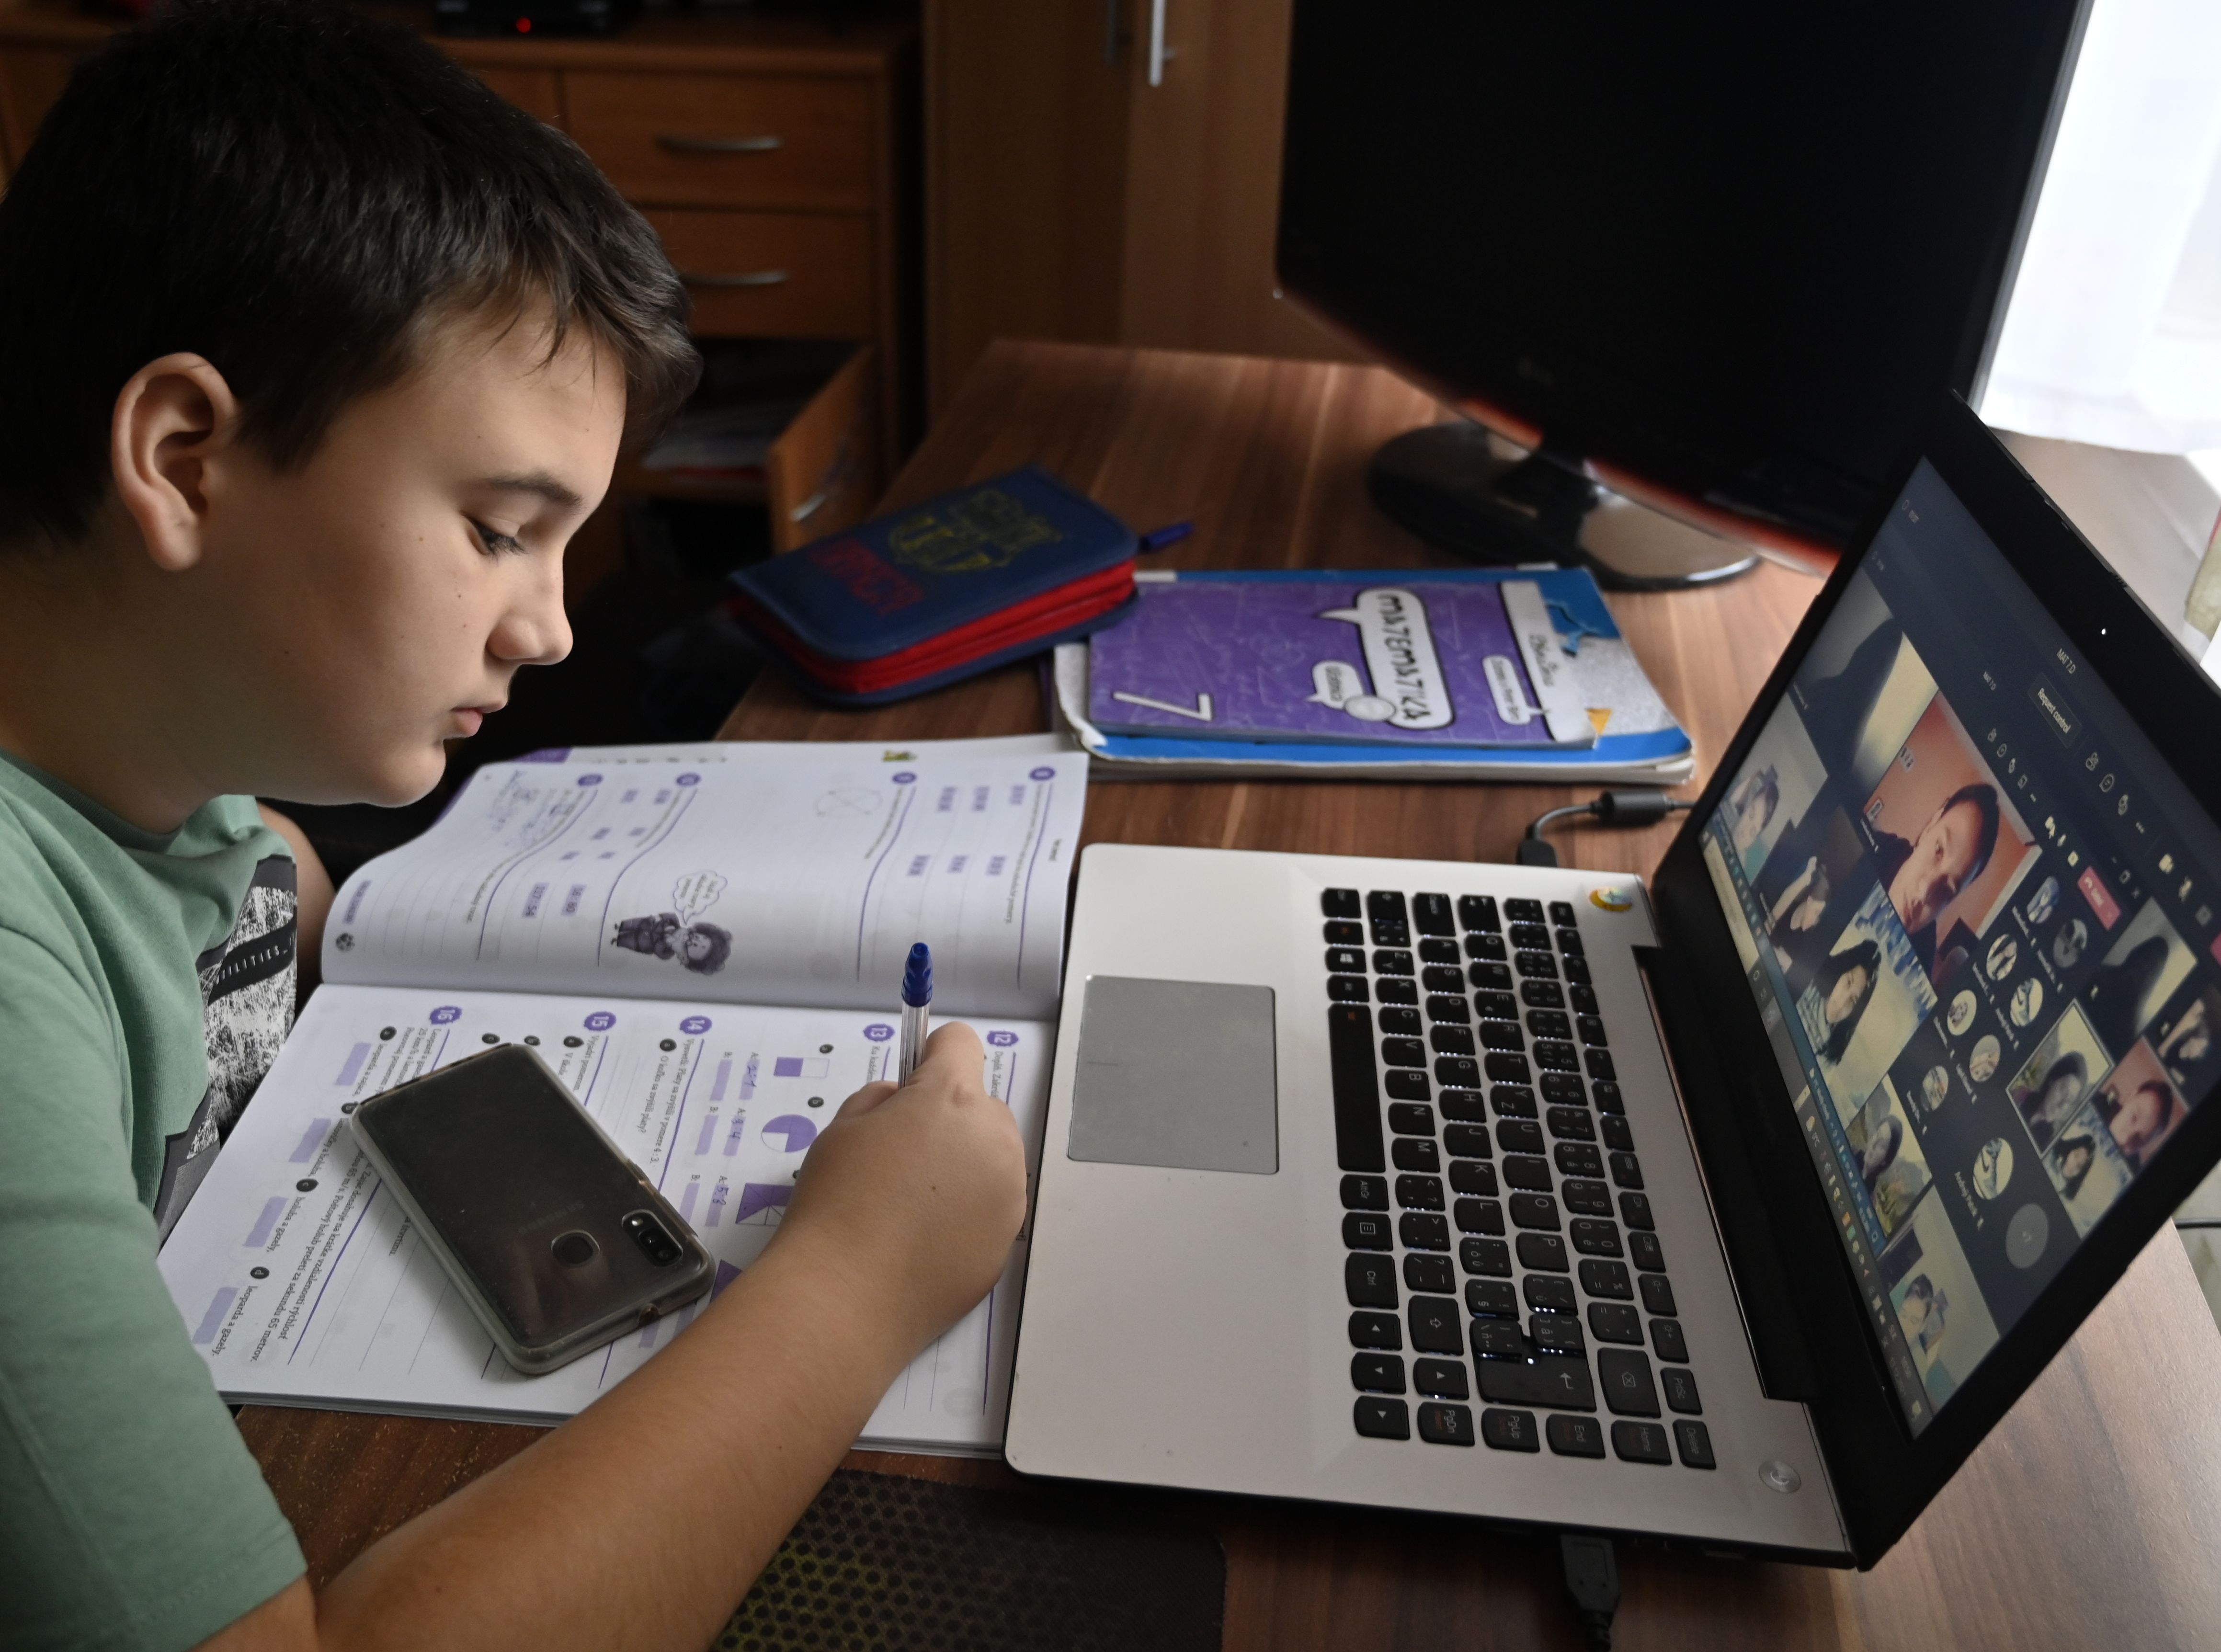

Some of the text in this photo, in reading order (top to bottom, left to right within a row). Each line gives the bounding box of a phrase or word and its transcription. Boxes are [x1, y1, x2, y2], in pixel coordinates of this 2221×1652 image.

[2057, 648, 2069, 665] MAT
[2037, 687, 2072, 735] Request control
[1486, 936, 1498, 946] Q
[1492, 965, 1504, 975] W
[1398, 980, 1411, 989] X
[437, 1009, 456, 1021] 16
[592, 1016, 609, 1027] 15
[687, 1020, 705, 1030] 14
[870, 1027, 888, 1037] 13
[993, 1034, 1008, 1043] 12
[1405, 1041, 1417, 1050] V
[367, 1043, 388, 1070] leoparda
[1458, 1060, 1471, 1069] G
[1463, 1093, 1476, 1102] H
[1412, 1106, 1426, 1116] N
[655, 1121, 668, 1146] pomere
[1521, 1124, 1534, 1132] U
[1417, 1142, 1431, 1153] M
[1474, 1164, 1488, 1173] K
[285, 1196, 306, 1220] holuba
[338, 1190, 360, 1221] dosahuje
[1535, 1198, 1549, 1208] O
[333, 1223, 343, 1232] na
[266, 1227, 285, 1253] gazely,
[311, 1224, 330, 1245] holub
[320, 1234, 341, 1257] krátke
[1543, 1238, 1556, 1246] P
[292, 1272, 301, 1281] za
[1366, 1270, 1377, 1286] Ctrl
[231, 1286, 258, 1320] leoparda
[274, 1283, 296, 1316] sekundu
[268, 1318, 280, 1329] 65
[212, 1329, 231, 1356] gazely.
[251, 1330, 273, 1362] metrov.
[1445, 1409, 1457, 1434] PgDn
[1508, 1415, 1521, 1439] PgUp
[1574, 1424, 1586, 1443] End
[1640, 1426, 1651, 1452] Home
[1686, 1426, 1699, 1455] Delete
